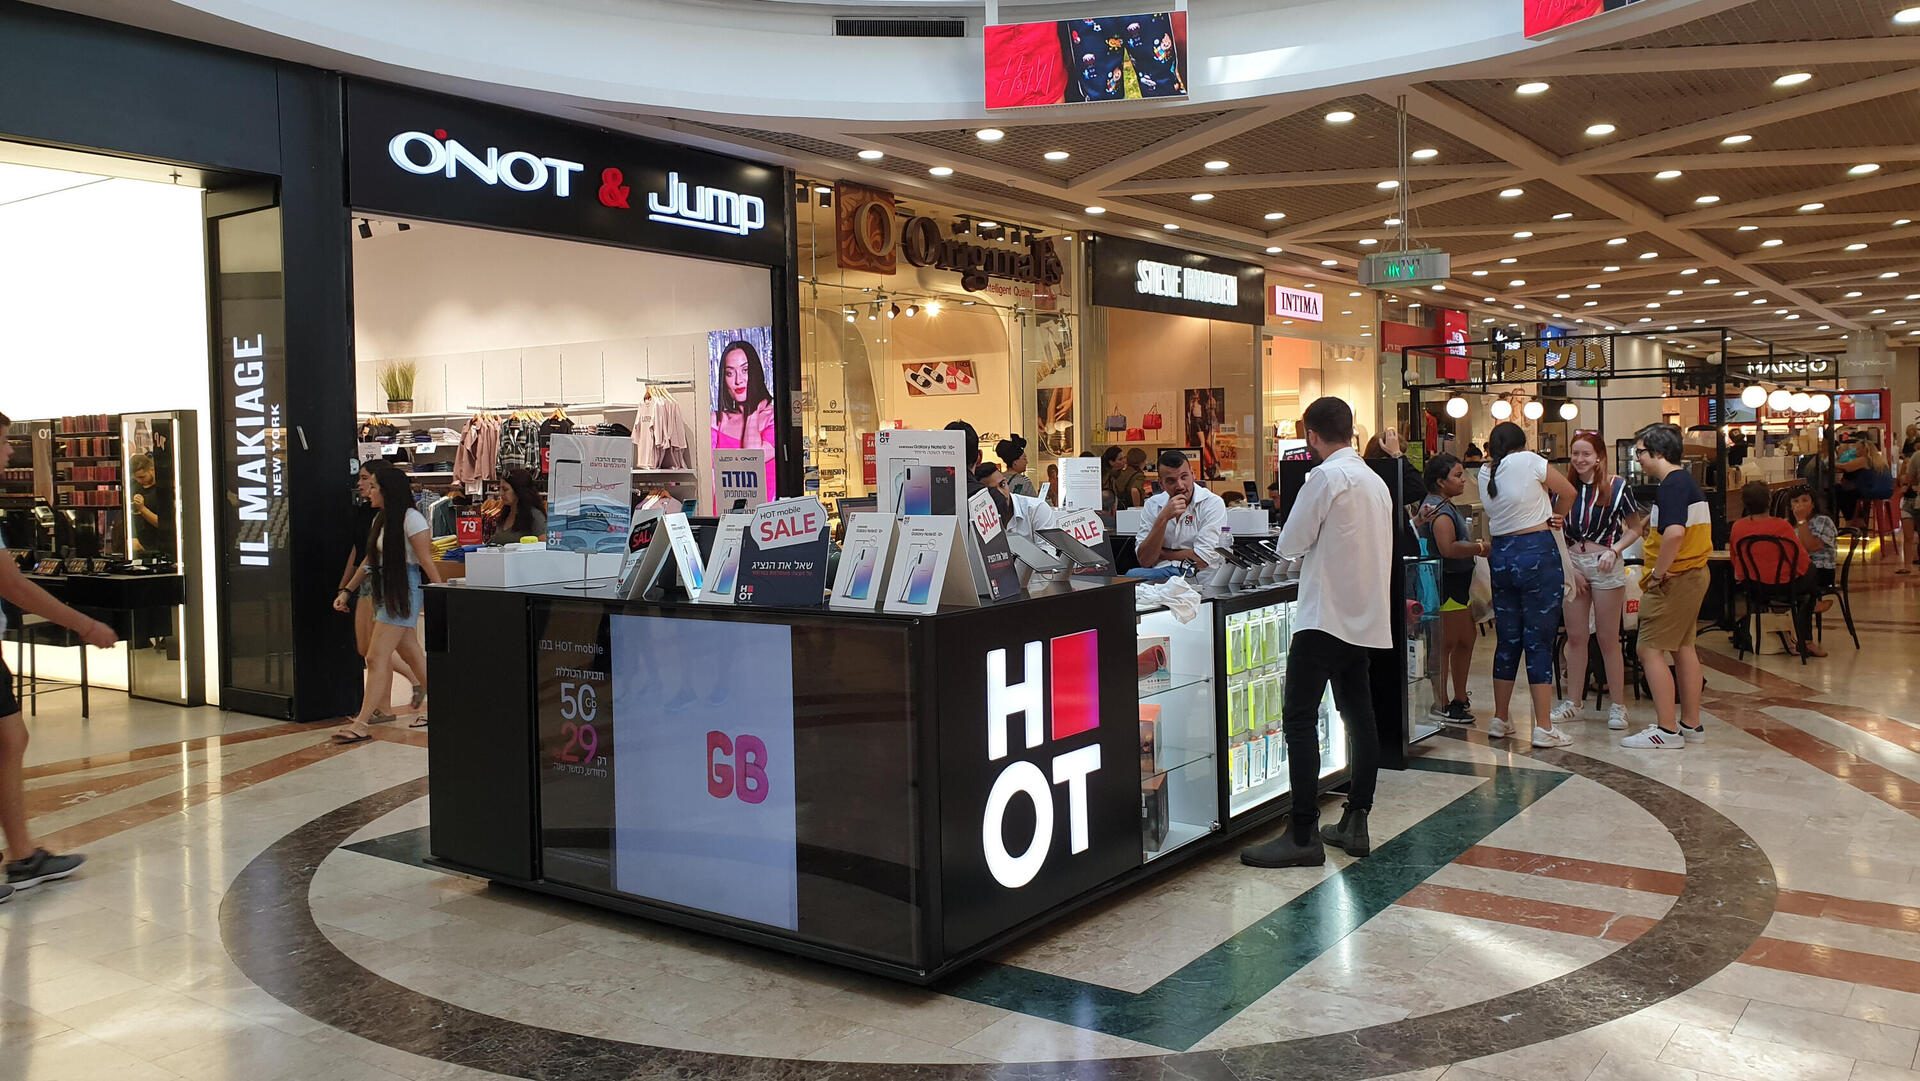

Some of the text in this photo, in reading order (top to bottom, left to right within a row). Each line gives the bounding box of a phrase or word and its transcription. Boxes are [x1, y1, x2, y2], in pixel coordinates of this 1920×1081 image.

[598, 167, 630, 209] &
[648, 172, 765, 236] Jump
[901, 216, 1063, 292] Originals
[986, 283, 1012, 296] ntelligent
[1013, 286, 1033, 300] Quality
[1136, 259, 1182, 298] STEVE
[1281, 292, 1319, 315] INTIMA
[1747, 359, 1828, 374] MANGO
[233, 333, 269, 566] IL MAKIAGE
[271, 403, 283, 496] NEW YORK
[722, 471, 758, 488] תודה
[760, 510, 776, 520] HOT
[777, 506, 801, 517] mobile
[977, 504, 998, 536] SALE
[632, 530, 653, 549] SAL
[760, 512, 817, 542] SALE
[751, 560, 814, 570] שאל את הנציג
[554, 641, 573, 652] HOT
[574, 643, 604, 655] mobile
[556, 667, 582, 679] הכוללת
[560, 682, 597, 721] 50
[585, 697, 597, 708] Gb
[561, 722, 607, 767] רק 29
[706, 730, 769, 804] GB
